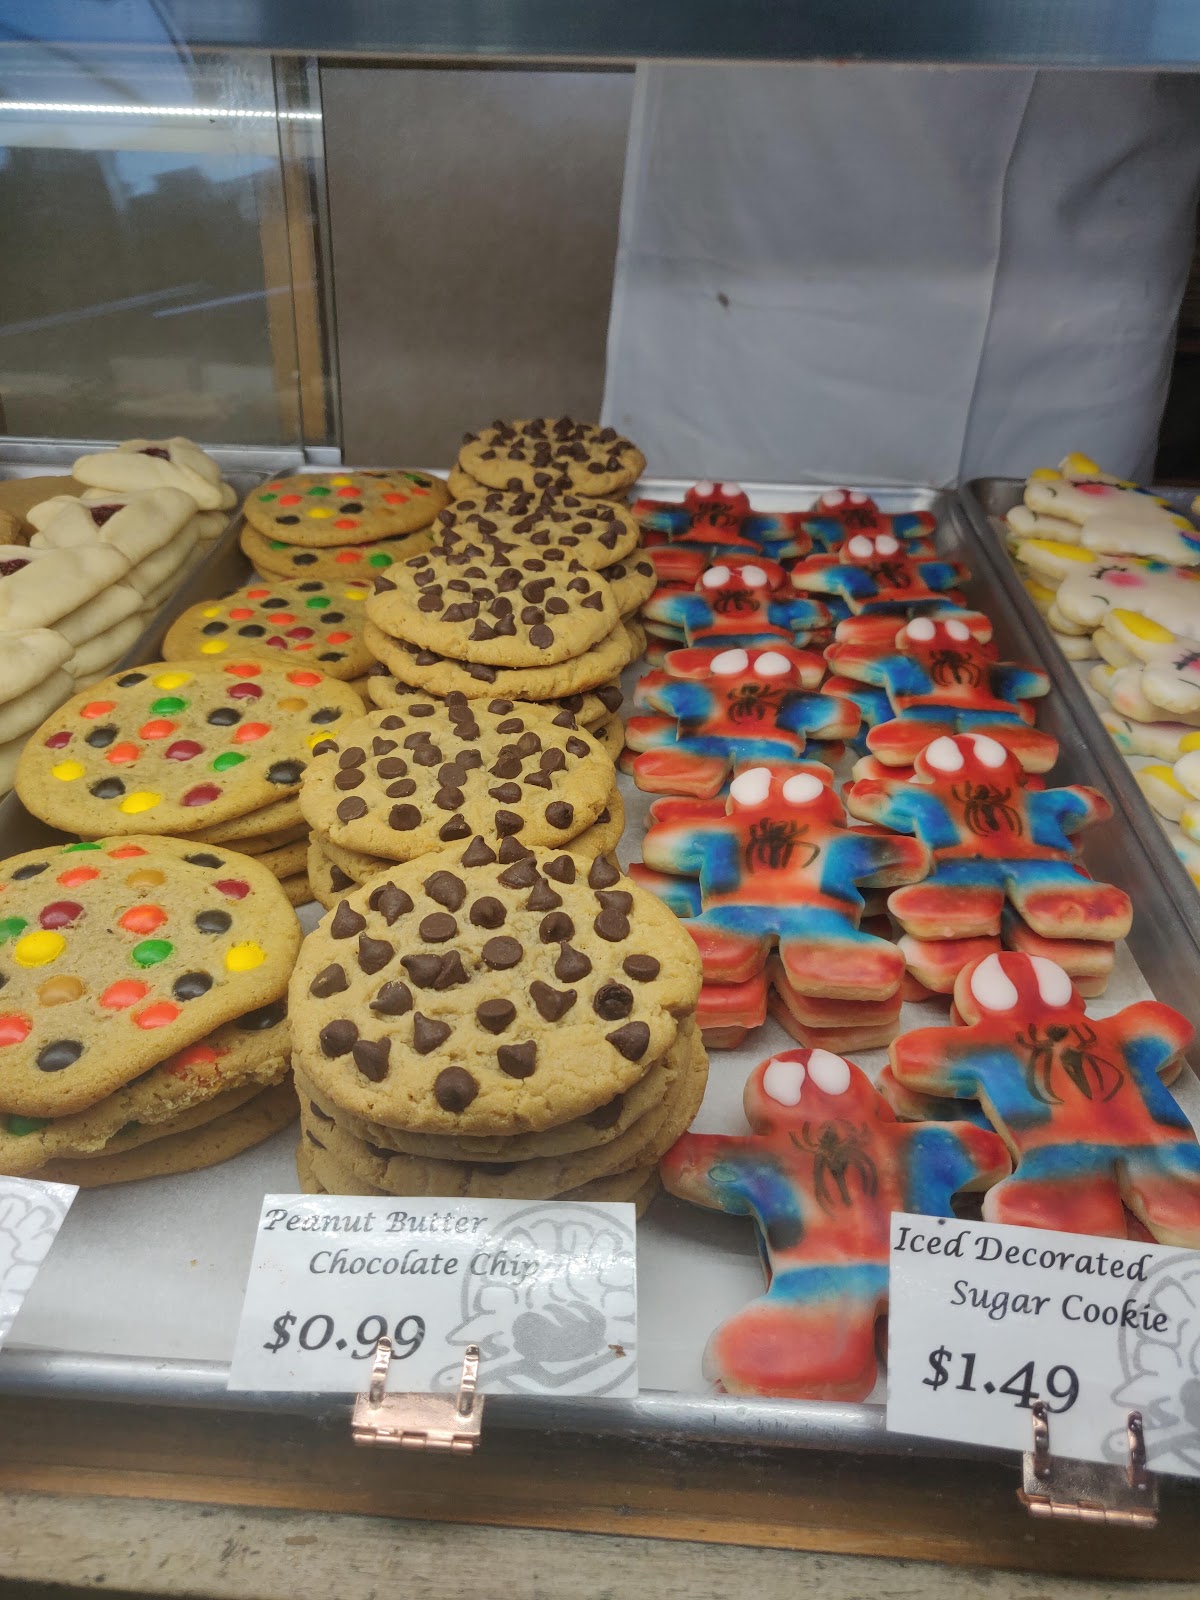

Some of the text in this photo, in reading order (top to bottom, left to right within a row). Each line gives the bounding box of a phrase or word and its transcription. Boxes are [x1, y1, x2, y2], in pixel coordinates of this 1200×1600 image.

[264, 1208, 488, 1234] Peanut Butter
[309, 1248, 540, 1284] Chocolate Chip
[894, 1227, 1153, 1282] Iced Decorated
[950, 1279, 1168, 1332] Sugar Cookie
[263, 1310, 426, 1360] $0.99
[922, 1345, 1080, 1413] $1.49
